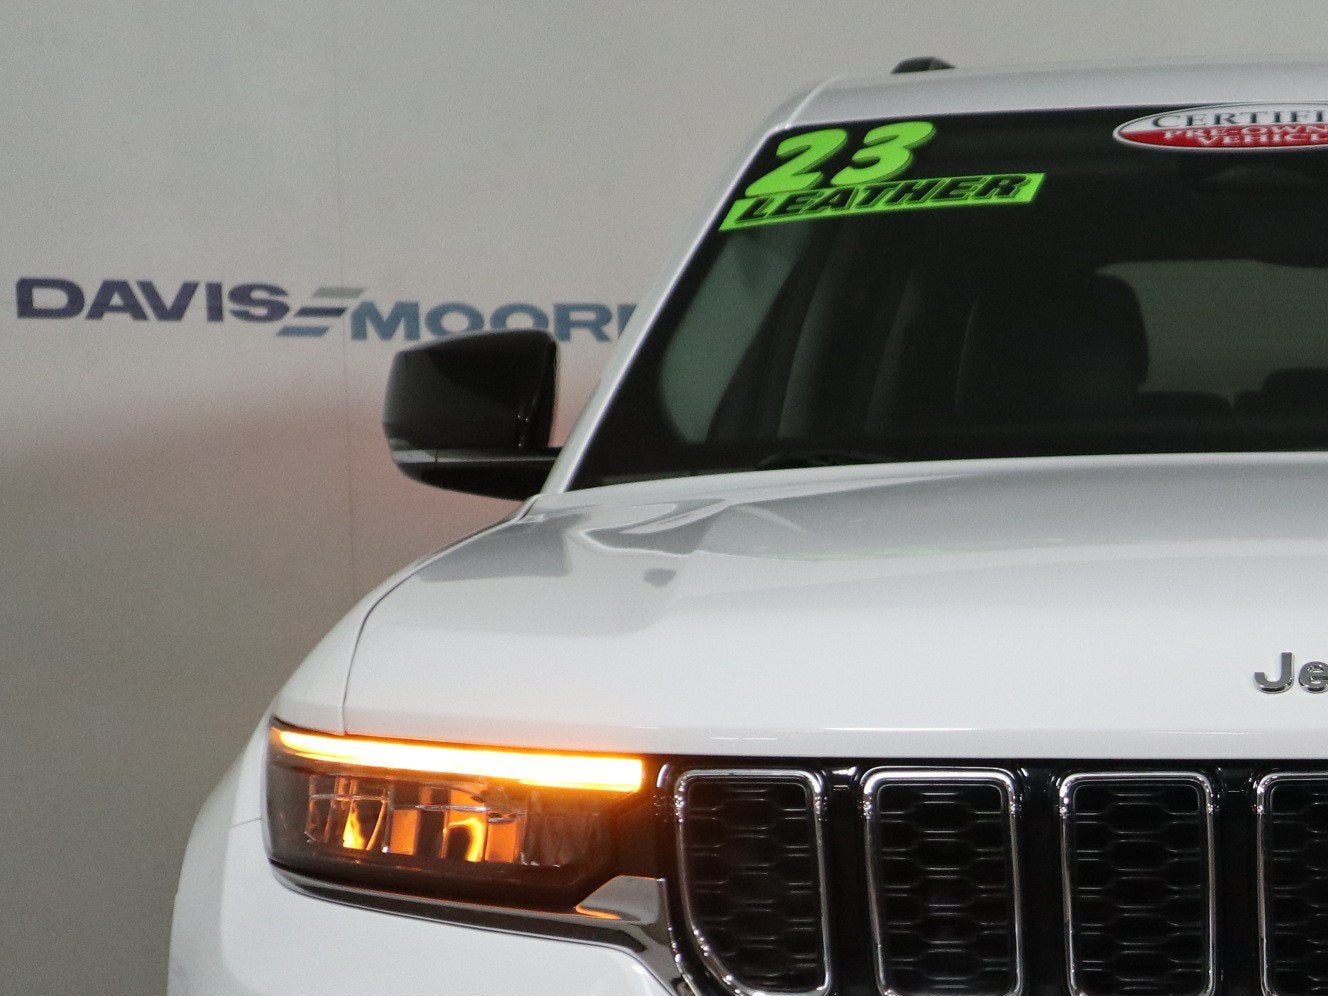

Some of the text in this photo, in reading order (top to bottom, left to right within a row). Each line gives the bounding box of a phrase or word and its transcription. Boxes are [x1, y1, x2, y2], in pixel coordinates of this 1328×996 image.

[745, 121, 938, 197] 23
[734, 174, 1032, 222] LEATHER
[15, 277, 290, 322] DAVIS
